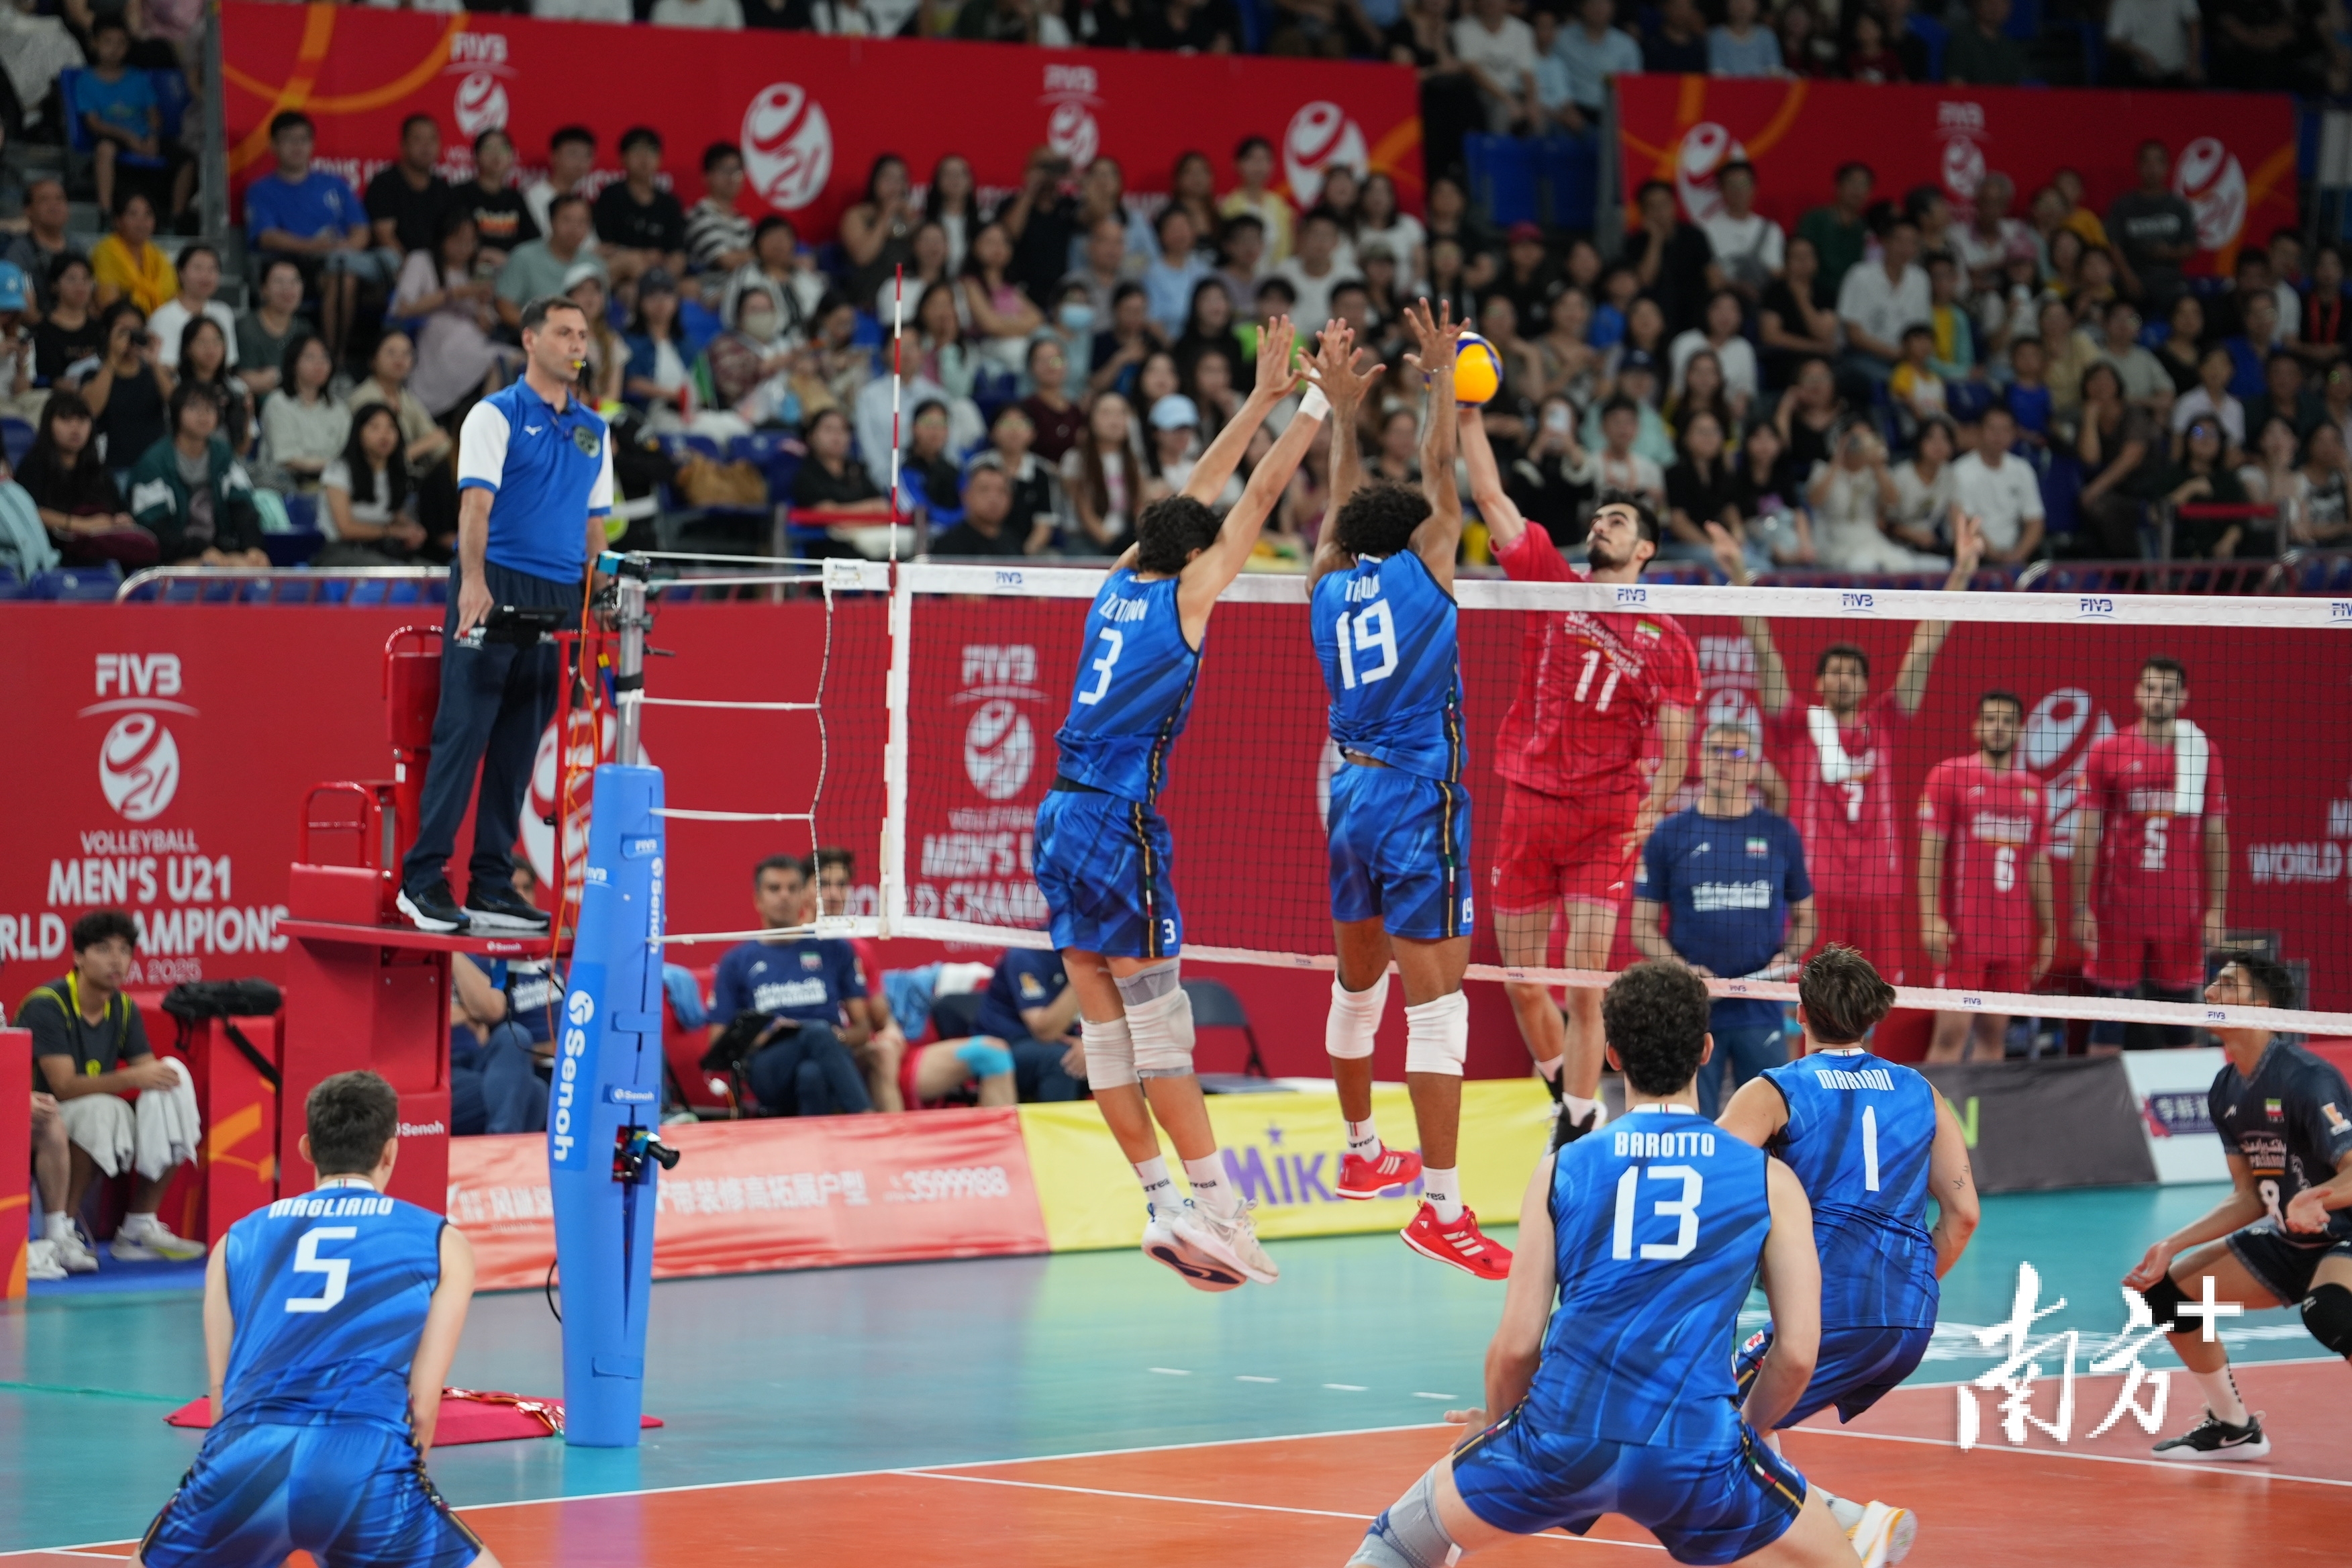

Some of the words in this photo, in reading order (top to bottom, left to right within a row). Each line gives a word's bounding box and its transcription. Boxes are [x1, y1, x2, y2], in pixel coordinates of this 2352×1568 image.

[995, 571, 1022, 585] FIVB
[1618, 589, 1646, 601] FIVB
[1843, 593, 1873, 607] FIVB
[2081, 598, 2112, 612] FIVB
[1336, 599, 1400, 690] 19
[96, 653, 183, 696] FIVB
[962, 644, 1038, 685] FIVB
[1077, 627, 1124, 706] 3
[1575, 649, 1622, 713] 11
[1841, 780, 1865, 822] 7
[80, 828, 199, 856] VOLLEYBALL
[635, 839, 657, 852] FIVB
[1994, 845, 2016, 893] 6
[2247, 842, 2343, 885] WORLD
[47, 857, 158, 906] MEN'S
[166, 855, 232, 903] U21
[649, 879, 663, 954] Senoh
[1462, 897, 1473, 924] 19
[132, 905, 289, 957] AMPIONS
[1163, 918, 1176, 945] 3
[495, 942, 522, 951] Senoh
[147, 959, 202, 984] 2025
[1729, 984, 1747, 993] FIVB
[1963, 997, 1981, 1006] FIVB
[2208, 1011, 2226, 1020] FIVB
[1814, 1068, 1896, 1091] MARIANI
[554, 1028, 586, 1162] Senoh
[624, 1089, 654, 1101] Senoh
[401, 1120, 444, 1137] Senoh
[1614, 1131, 1716, 1157] BAROTTO
[1861, 1105, 1879, 1192] 1
[902, 1165, 1011, 1202] 3599988
[268, 1197, 395, 1219] MAGLIANO
[1612, 1165, 1704, 1261] 13
[2259, 1179, 2287, 1234] 9
[284, 1226, 358, 1314] 5
